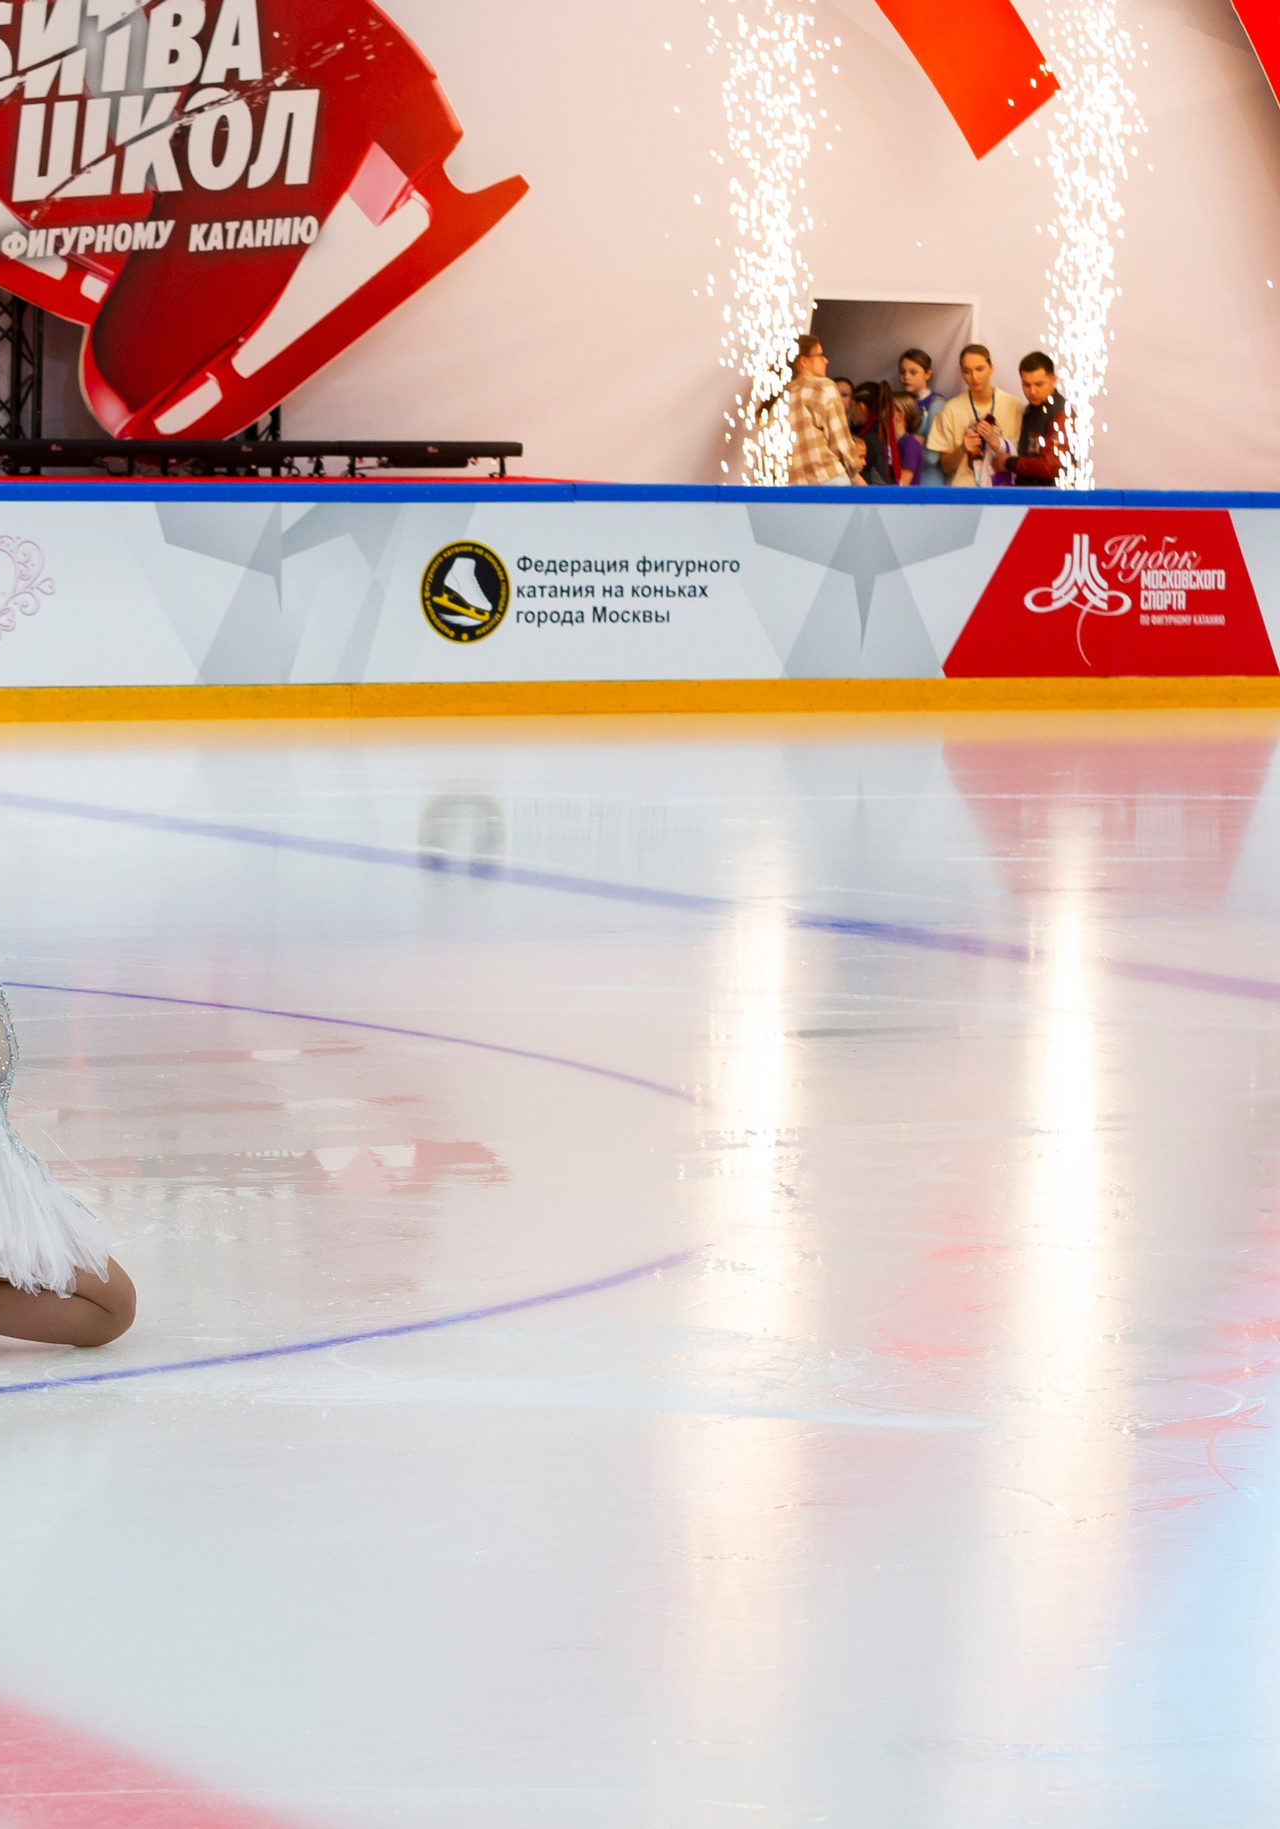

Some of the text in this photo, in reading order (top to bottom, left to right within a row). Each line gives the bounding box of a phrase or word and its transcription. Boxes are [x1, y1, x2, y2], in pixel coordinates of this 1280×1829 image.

[12, 87, 320, 202] ШКОЛ
[1, 220, 176, 259] ФИГУРНОМУ
[188, 215, 320, 253] КАТАНИЮ
[516, 555, 740, 578] Федерация фигурного
[1100, 534, 1203, 584] Кубок
[1140, 569, 1226, 590] МОСКОВСКОГО
[516, 584, 709, 599] катания на коньках
[1139, 590, 1187, 611] СПОРТА
[516, 606, 670, 628] города Москвы
